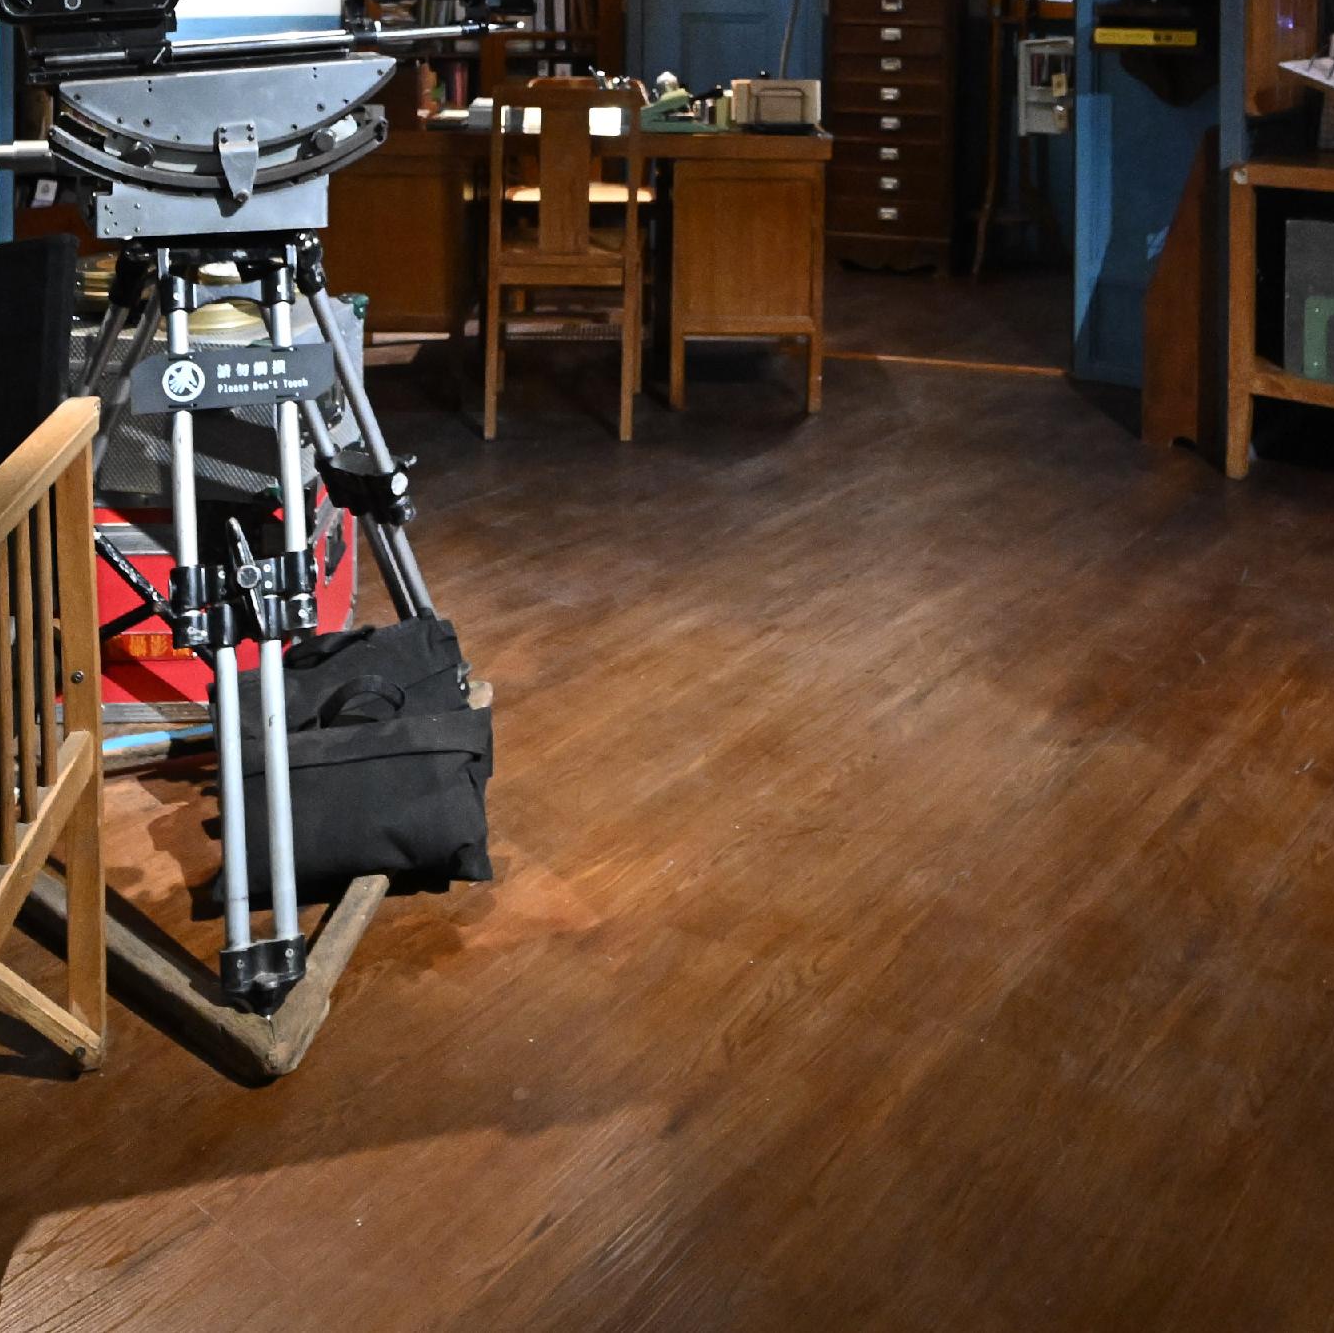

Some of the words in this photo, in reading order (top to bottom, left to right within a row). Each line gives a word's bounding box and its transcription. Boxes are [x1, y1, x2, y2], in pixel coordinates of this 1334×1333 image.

[218, 384, 249, 394] Please
[253, 380, 278, 391] Don't
[284, 378, 308, 388] Touch
